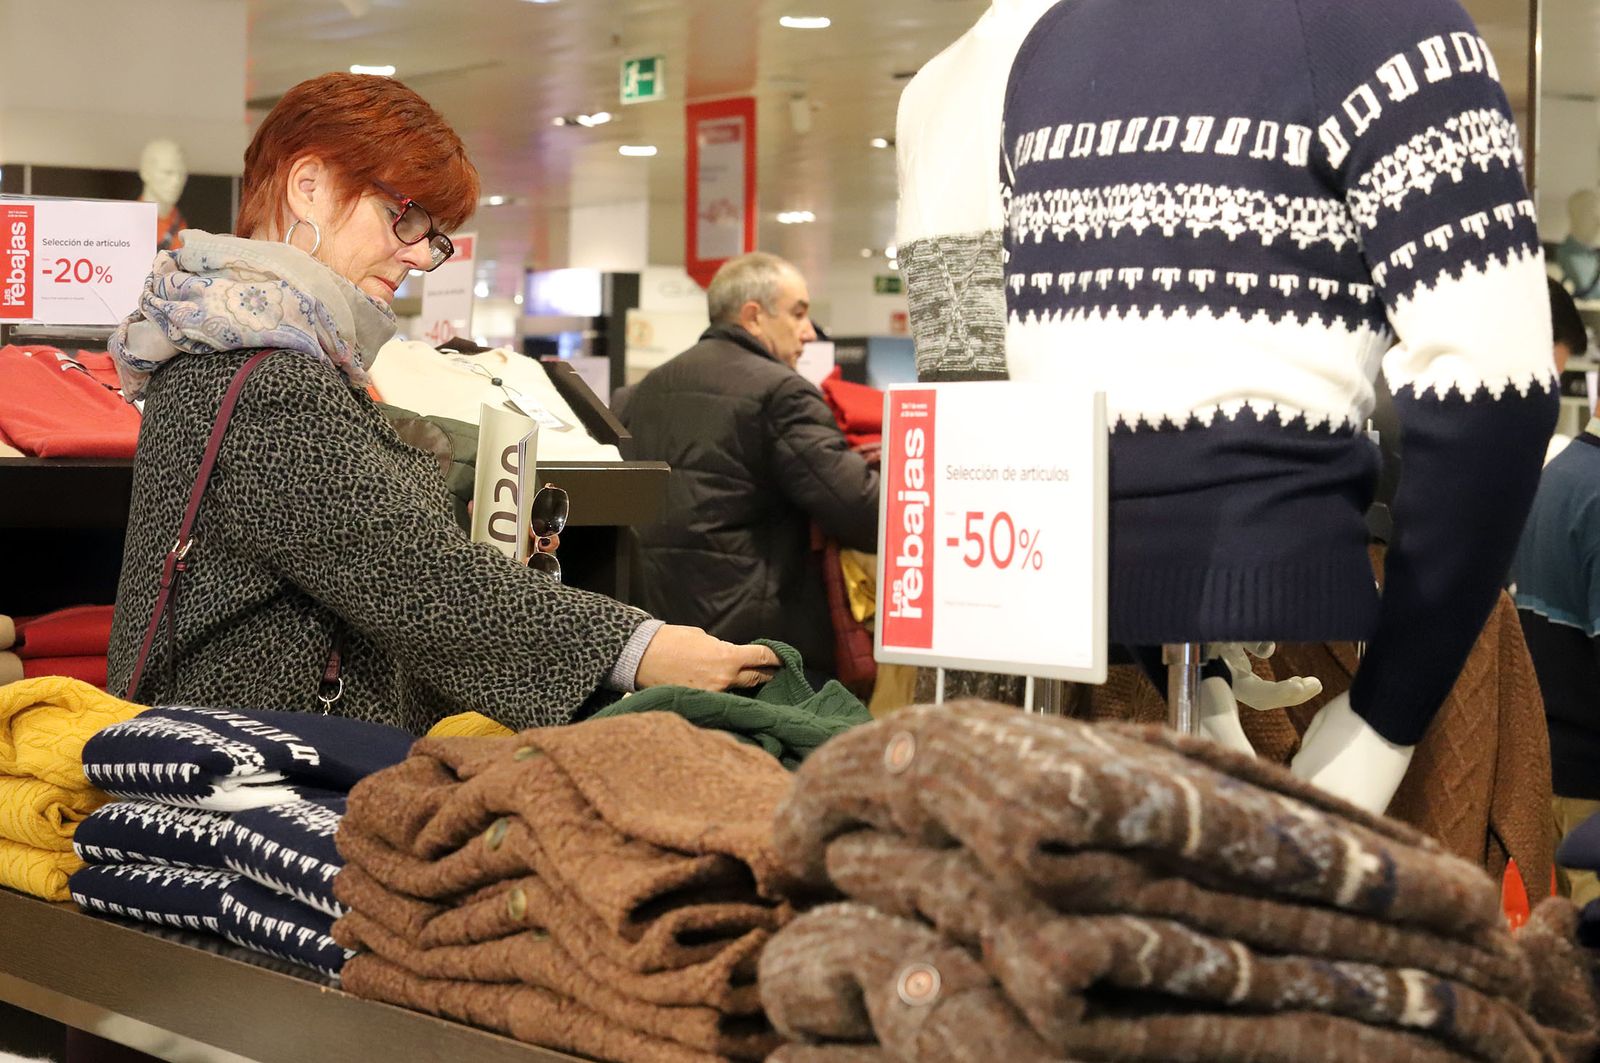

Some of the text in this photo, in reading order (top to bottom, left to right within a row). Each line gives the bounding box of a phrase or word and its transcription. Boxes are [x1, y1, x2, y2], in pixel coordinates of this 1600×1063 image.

[42, 238, 131, 248] Selección de artículos
[6, 221, 30, 306] rebajas
[42, 257, 113, 284] -20%
[2, 288, 11, 306] Las
[946, 464, 999, 481] Selección
[1002, 465, 1017, 481] de
[897, 427, 930, 619] rebajas
[946, 511, 1043, 571] -50%
[889, 579, 903, 618] Las
